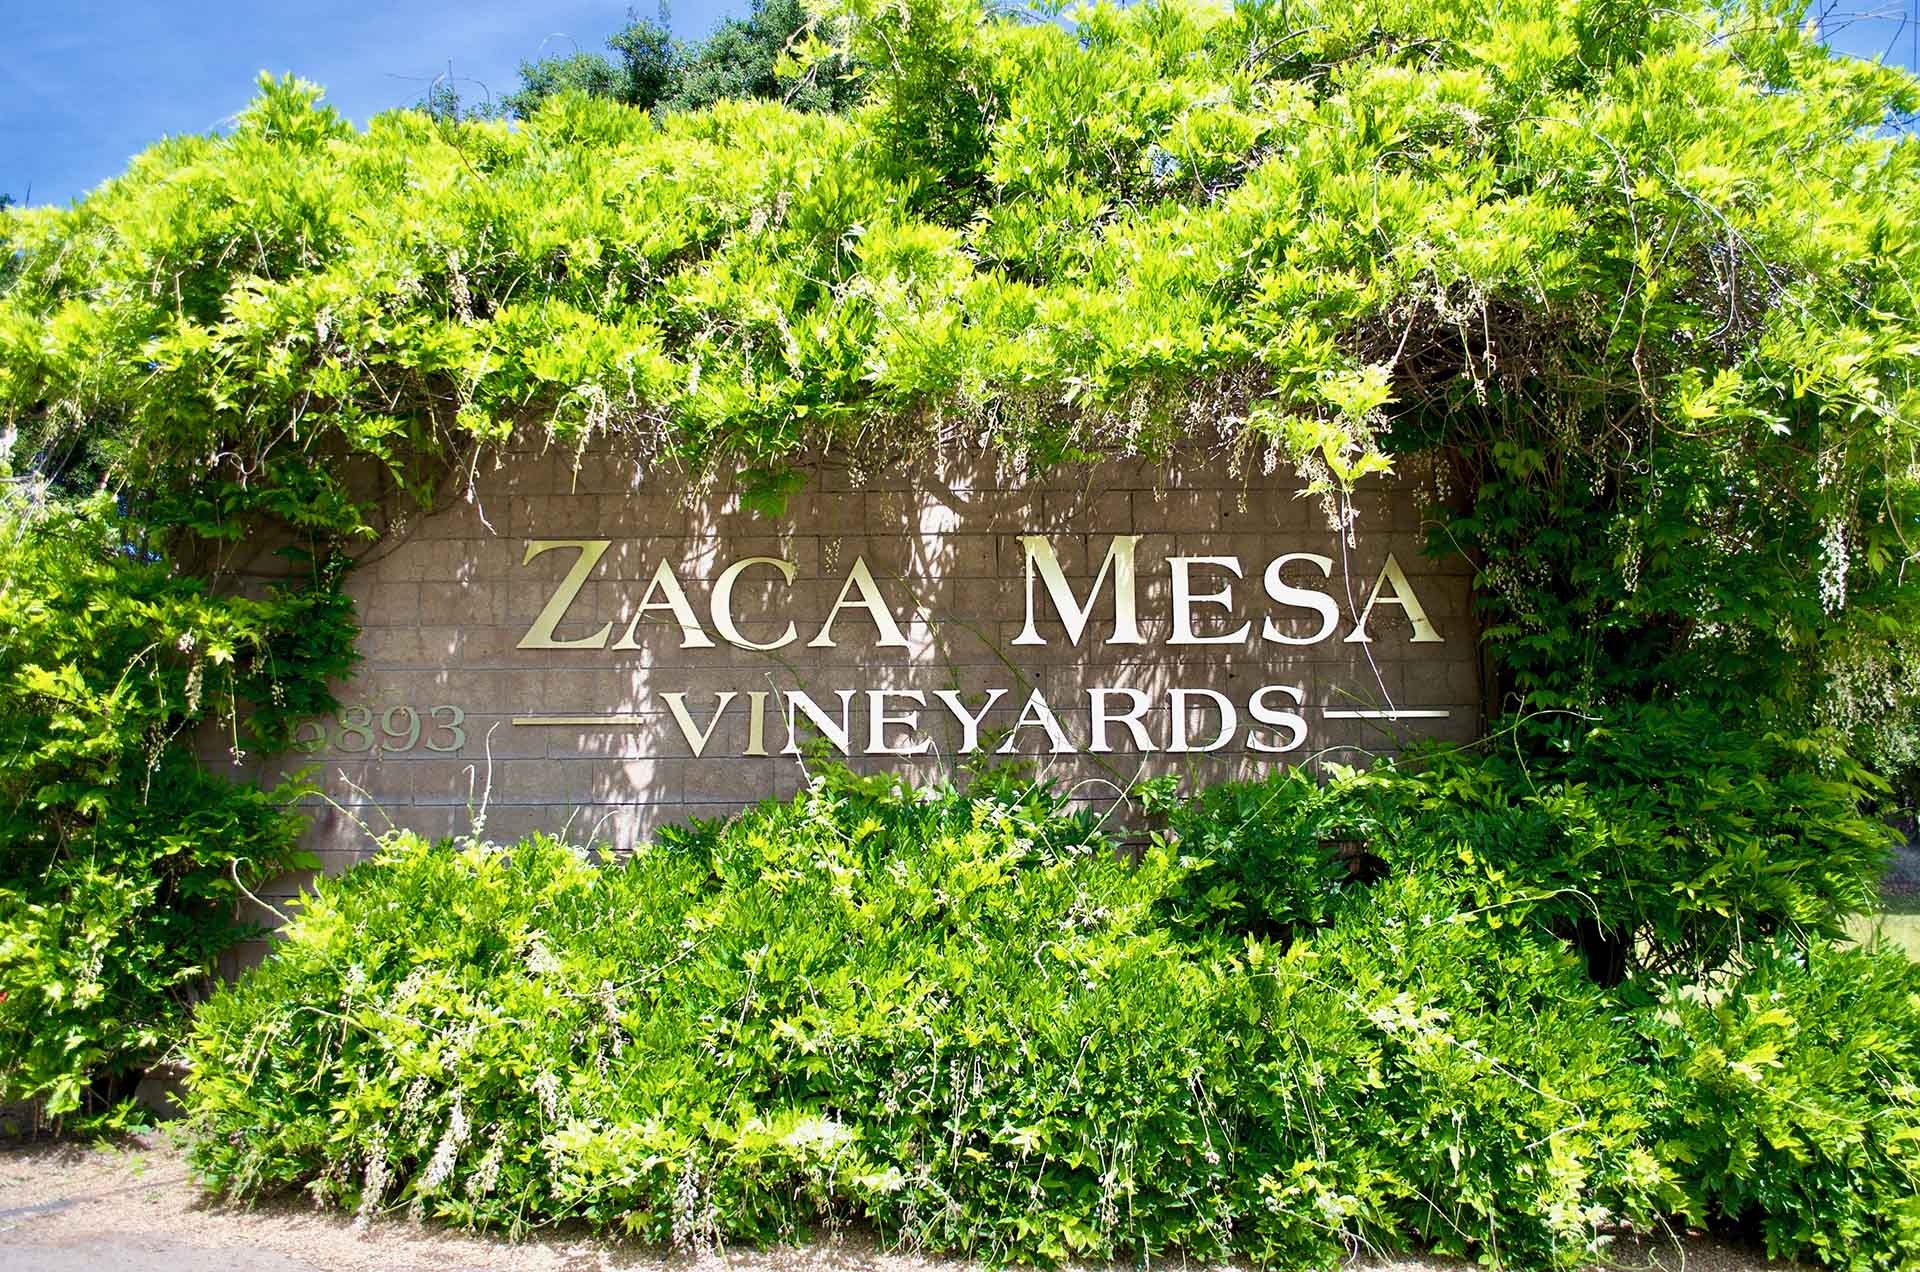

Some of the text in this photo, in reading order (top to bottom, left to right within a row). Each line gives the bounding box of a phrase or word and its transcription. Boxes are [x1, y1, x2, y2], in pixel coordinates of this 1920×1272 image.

[515, 534, 1446, 651] ZACA MESA
[658, 684, 1308, 758] VINEYARDS
